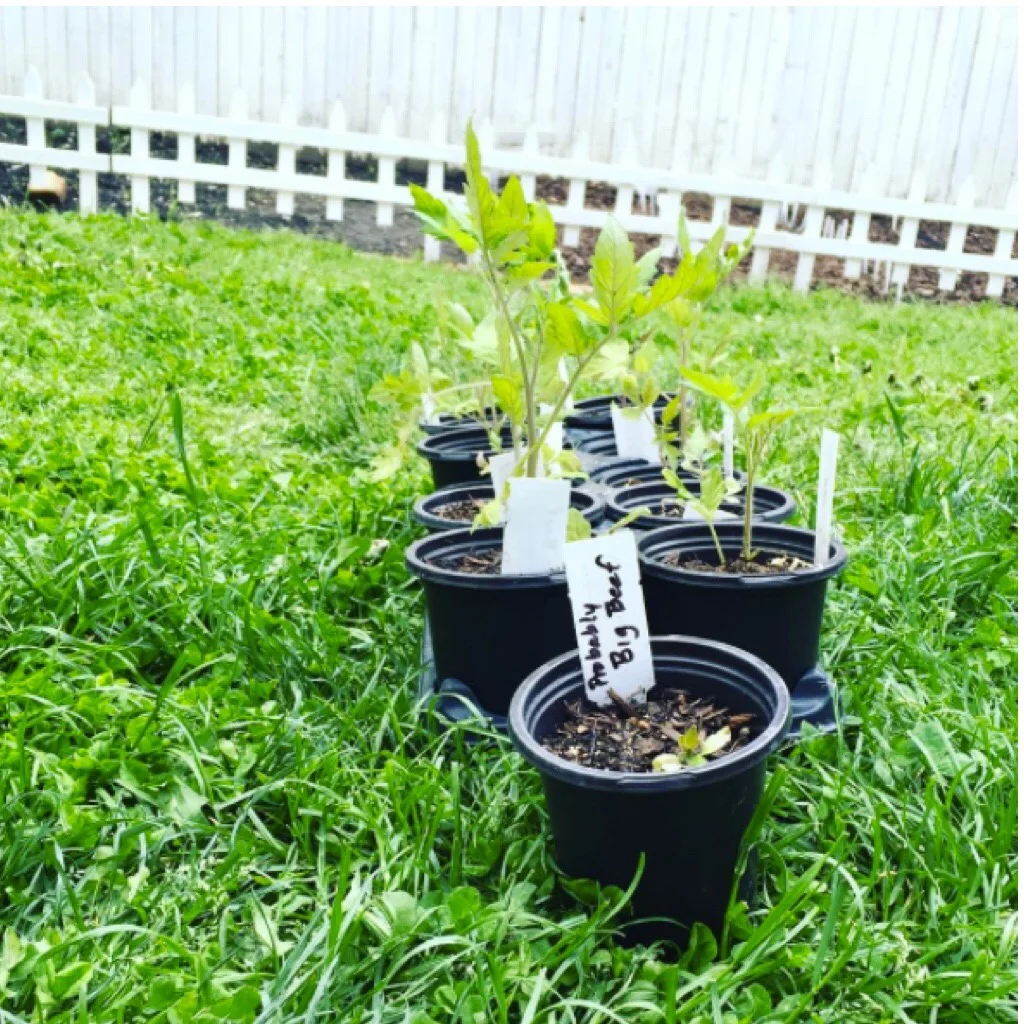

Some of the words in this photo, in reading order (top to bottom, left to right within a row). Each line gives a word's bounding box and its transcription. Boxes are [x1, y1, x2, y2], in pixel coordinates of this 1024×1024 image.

[594, 553, 625, 618] Beef
[579, 603, 609, 691] Probably
[609, 626, 640, 670] Big
